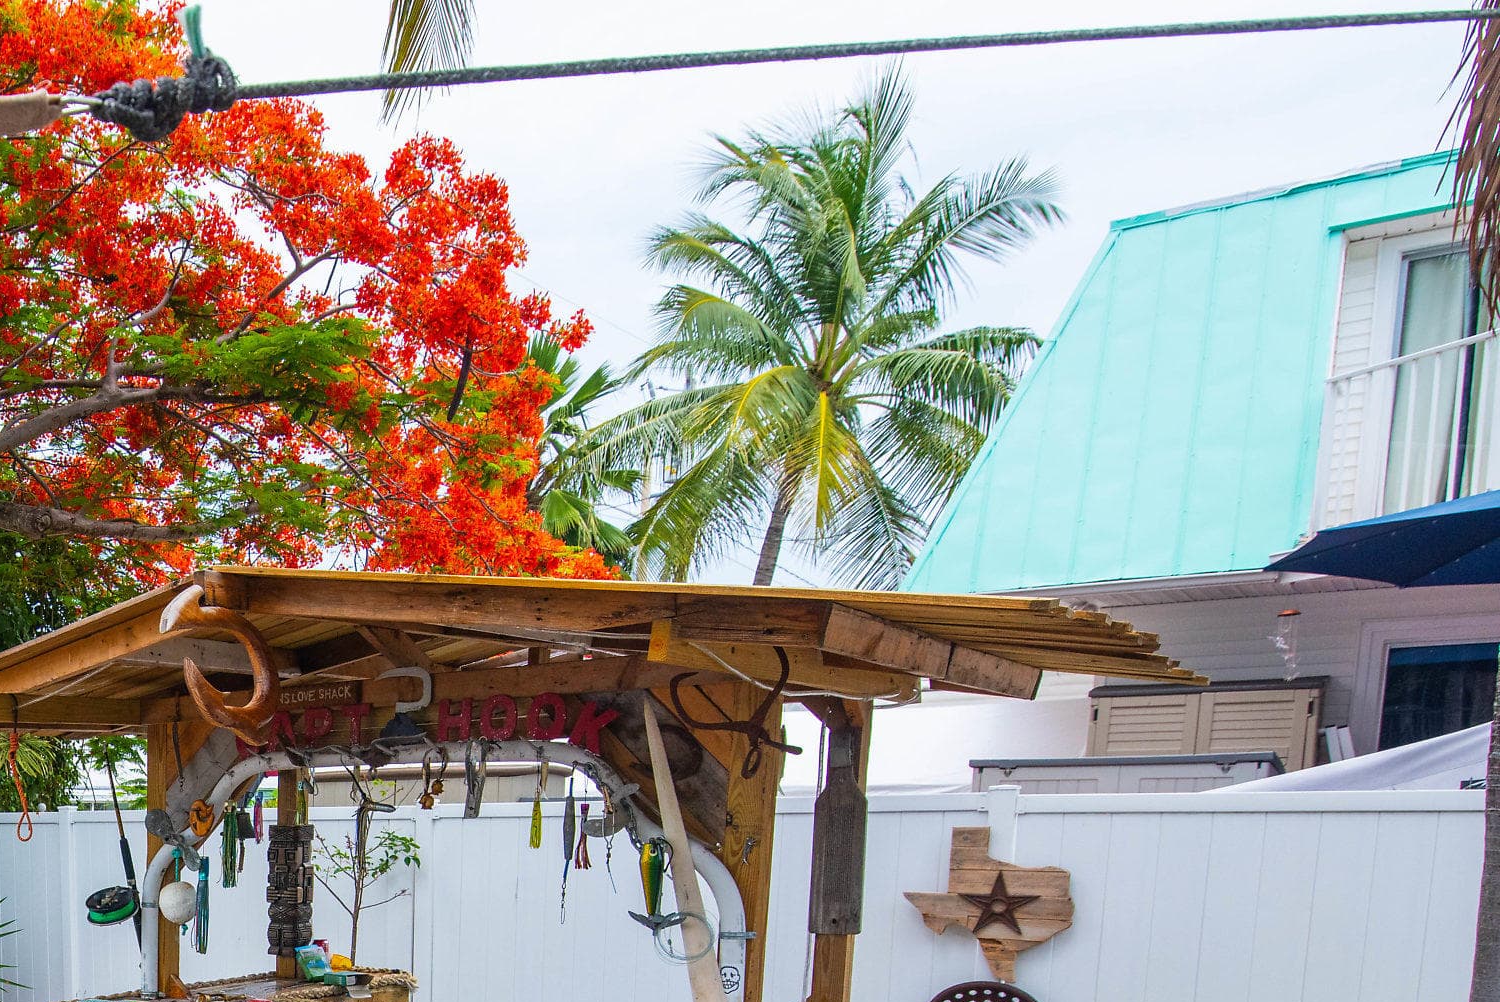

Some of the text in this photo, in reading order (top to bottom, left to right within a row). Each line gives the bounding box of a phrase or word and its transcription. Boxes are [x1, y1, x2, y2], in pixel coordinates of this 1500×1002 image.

[292, 690, 316, 703] LOVE
[318, 685, 352, 699] SHACK
[435, 691, 621, 757] HOOK
